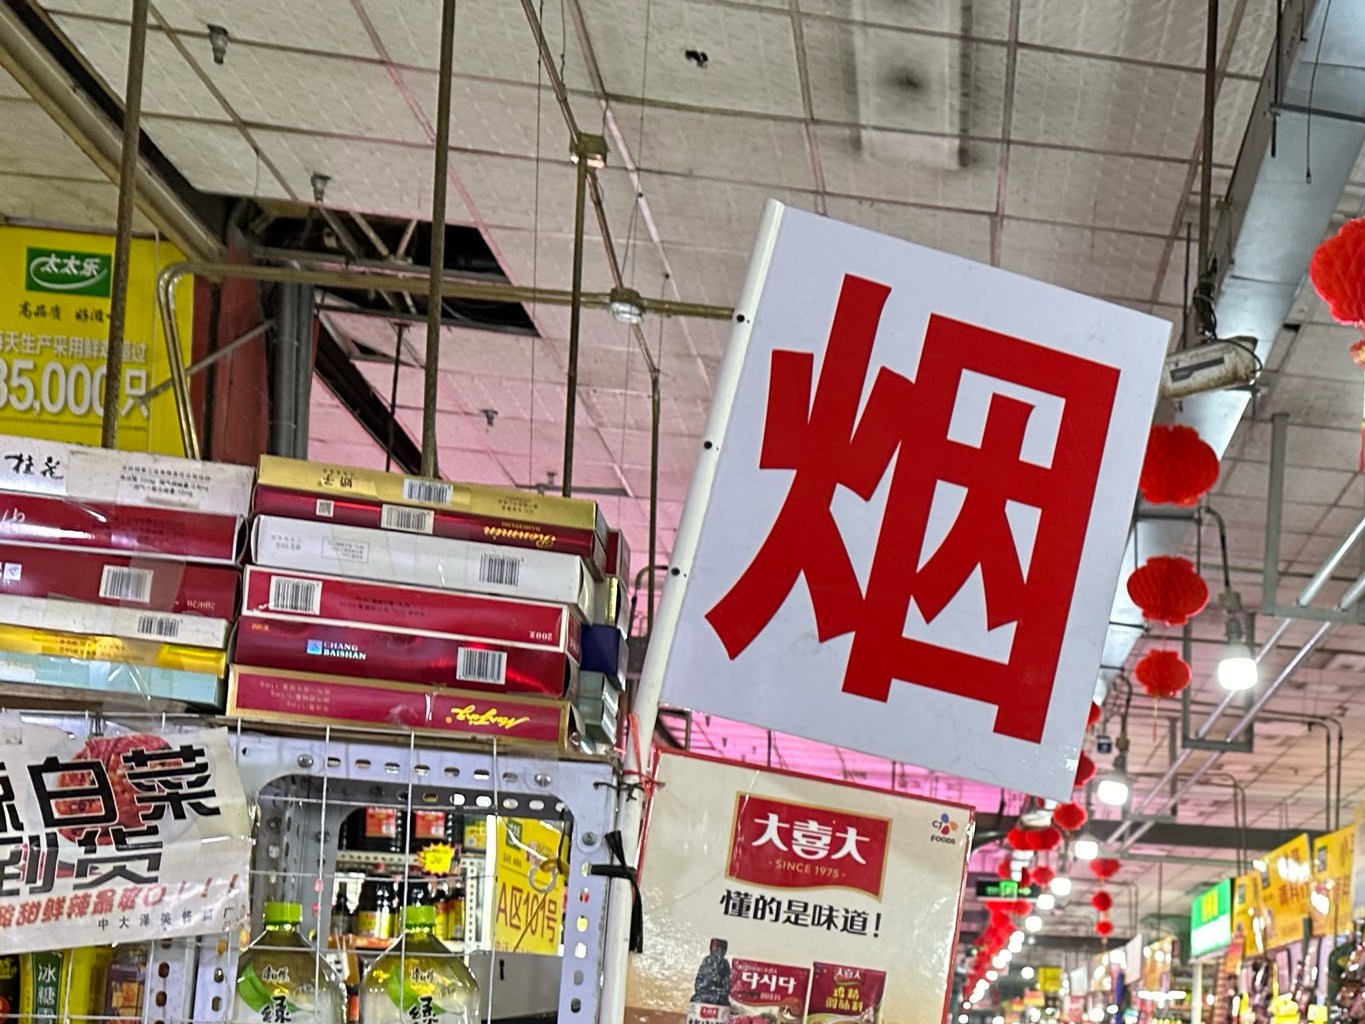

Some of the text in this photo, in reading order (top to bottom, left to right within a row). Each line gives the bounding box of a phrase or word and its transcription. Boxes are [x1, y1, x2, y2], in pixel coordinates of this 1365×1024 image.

[40, 252, 101, 276] 太太乐
[19, 301, 111, 324] 高品质 好滋
[704, 273, 1121, 744] 烟
[482, 524, 557, 549] Renmin
[323, 640, 359, 652] CHANG
[323, 649, 367, 660] BAISHAN
[751, 812, 870, 865] 大喜大
[931, 835, 956, 845] FOODS
[0, 825, 163, 897] 到货
[775, 859, 840, 878] SINCE 1975
[721, 888, 883, 938] 懂的是味道！
[741, 971, 797, 995] 다시다
